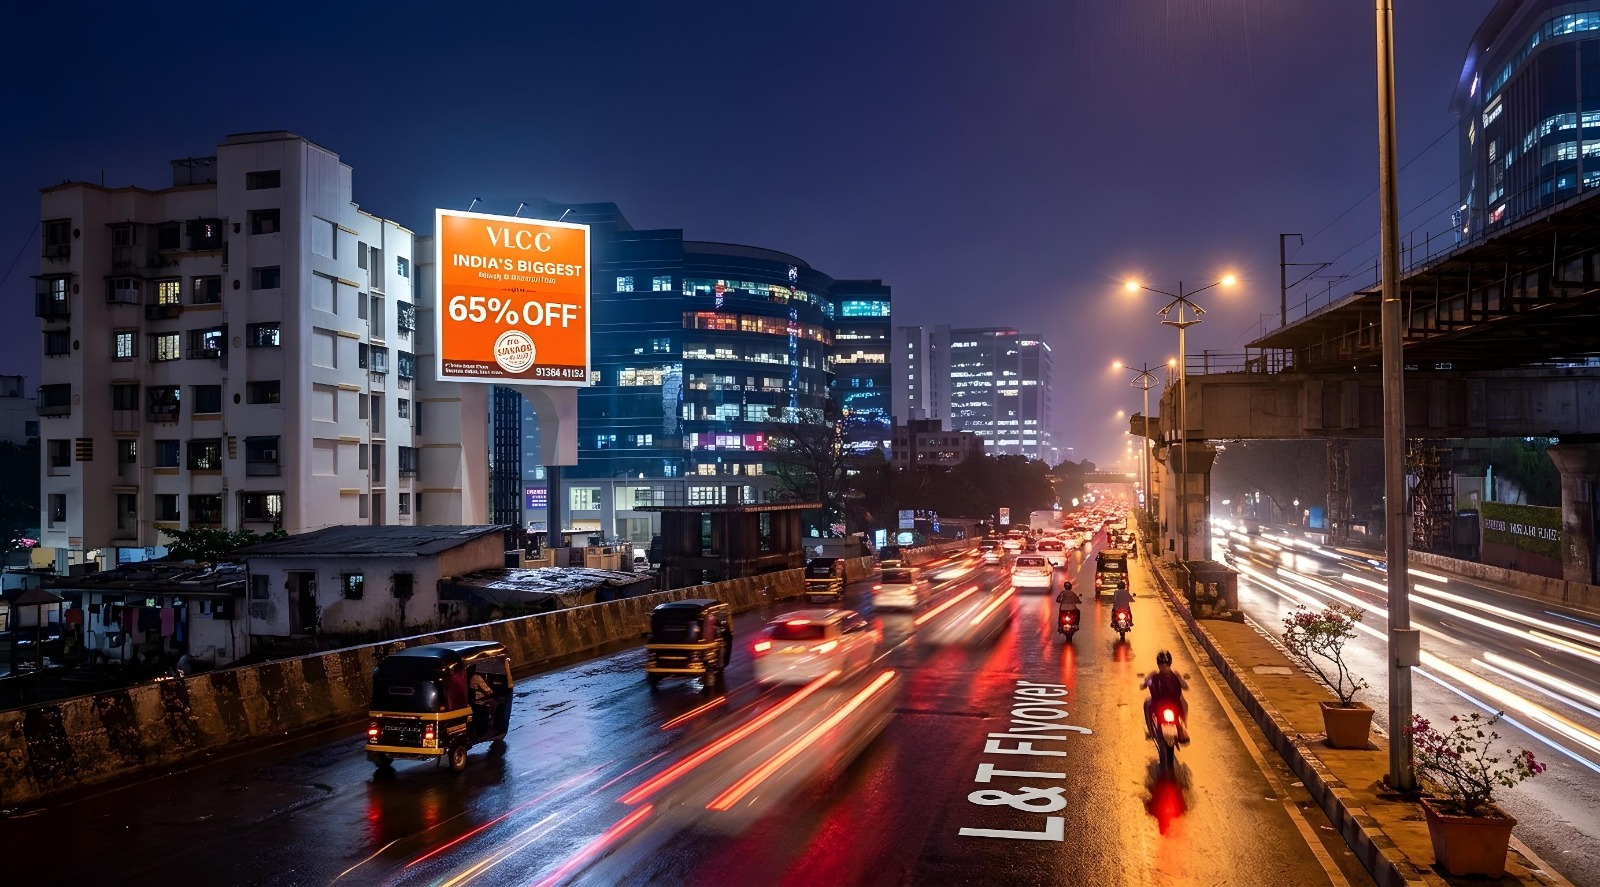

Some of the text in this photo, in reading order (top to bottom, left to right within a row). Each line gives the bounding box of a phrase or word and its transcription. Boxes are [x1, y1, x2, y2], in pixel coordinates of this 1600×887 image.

[486, 226, 551, 252] VLCC
[453, 253, 582, 277] INDIA'S BIGGEST
[449, 295, 519, 325] 65%
[535, 367, 560, 377] 91364
[983, 680, 1093, 757] Flyover
